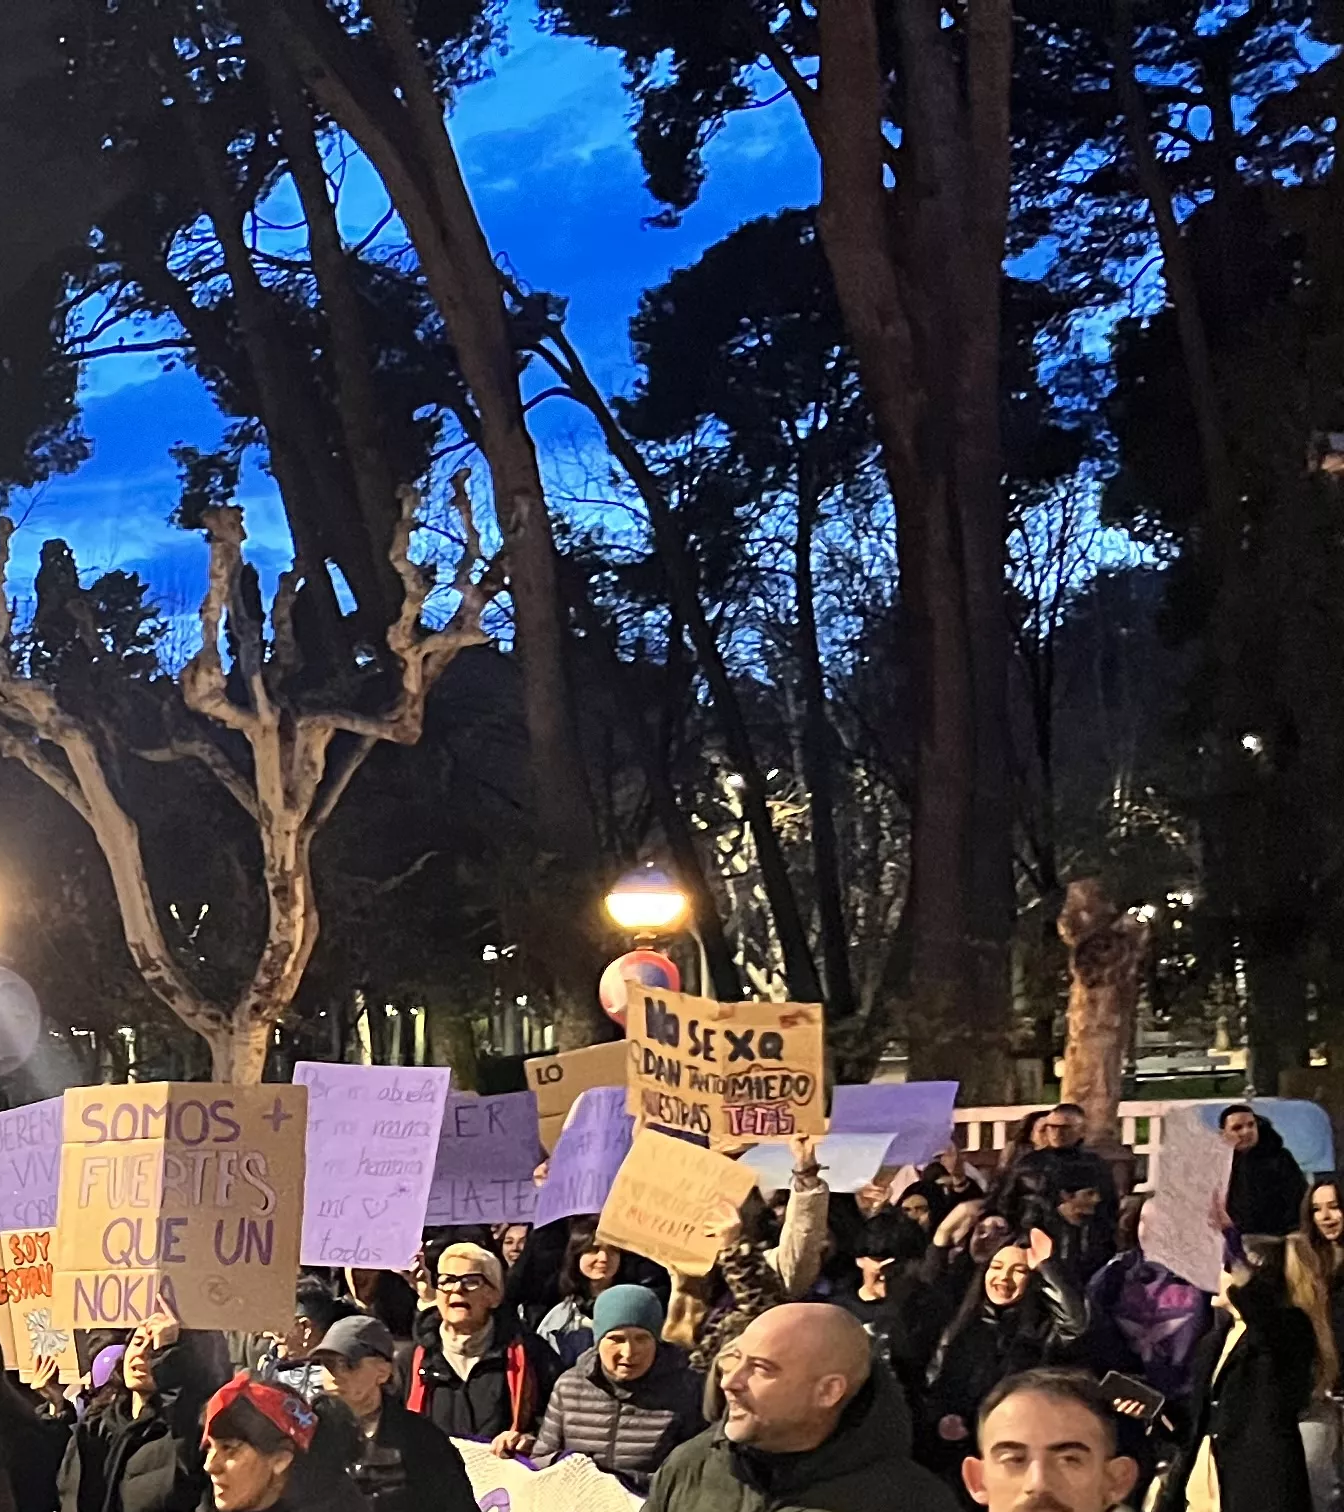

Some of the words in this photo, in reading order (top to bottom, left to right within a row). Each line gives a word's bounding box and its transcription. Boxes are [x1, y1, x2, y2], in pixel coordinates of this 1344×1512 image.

[82, 1099, 241, 1147] SOMOS
[78, 1149, 277, 1218] FUERTES
[8, 1231, 51, 1266] SOY
[102, 1216, 189, 1268] QUE
[214, 1216, 274, 1266] UN
[73, 1273, 181, 1323] NOKIA
